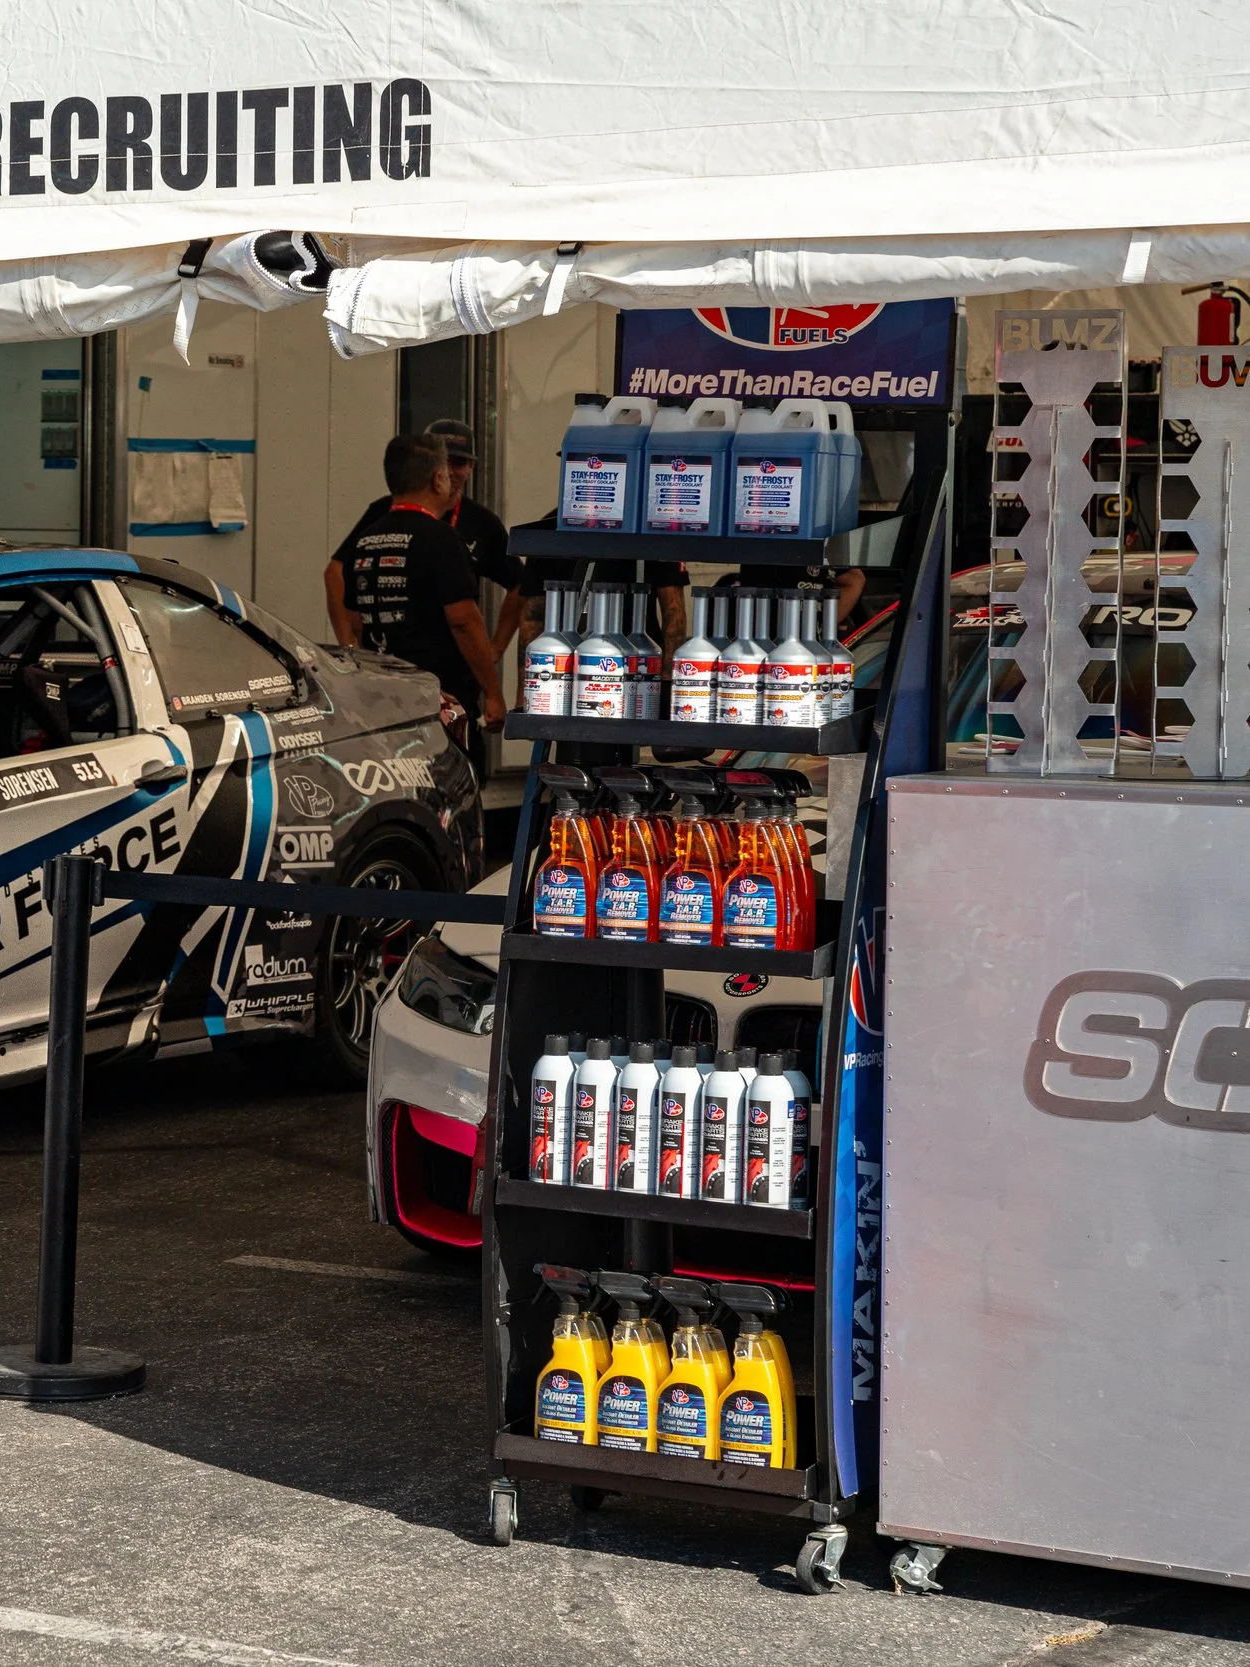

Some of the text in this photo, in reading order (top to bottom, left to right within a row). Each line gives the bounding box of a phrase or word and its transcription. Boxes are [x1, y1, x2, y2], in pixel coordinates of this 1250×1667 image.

[779, 327, 849, 344] FUELS
[1002, 317, 1120, 351] BUMZ
[629, 367, 939, 398] #MoreThanRaceFuel
[571, 470, 619, 480] STAY-FROSTY
[655, 473, 704, 483] STAY-FROSTY
[742, 475, 794, 485] STAY-FROSTY
[248, 674, 292, 690] SORENSEN
[278, 730, 324, 749] ODYSSEY
[72, 760, 103, 783] 513
[279, 830, 335, 862] OMP
[13, 807, 182, 940] FCE
[541, 884, 578, 901] POWER
[602, 887, 640, 903] POWER
[666, 890, 704, 906] POWER
[545, 905, 574, 914] REMOVER
[550, 898, 575, 908] T.A.R.
[612, 901, 638, 911] T.A.R.
[675, 904, 702, 914] T.A.R.
[729, 894, 768, 910] POWER
[607, 908, 637, 918] REMOVER
[670, 912, 701, 921] REMOVER
[734, 916, 765, 925] REMOVER
[739, 908, 766, 918] T.A.R.
[246, 992, 315, 1009] WHIPPLE
[543, 1388, 578, 1406] POWER
[603, 1395, 640, 1412] POWER
[662, 1402, 699, 1420] POWER
[726, 1410, 765, 1427] POWER
